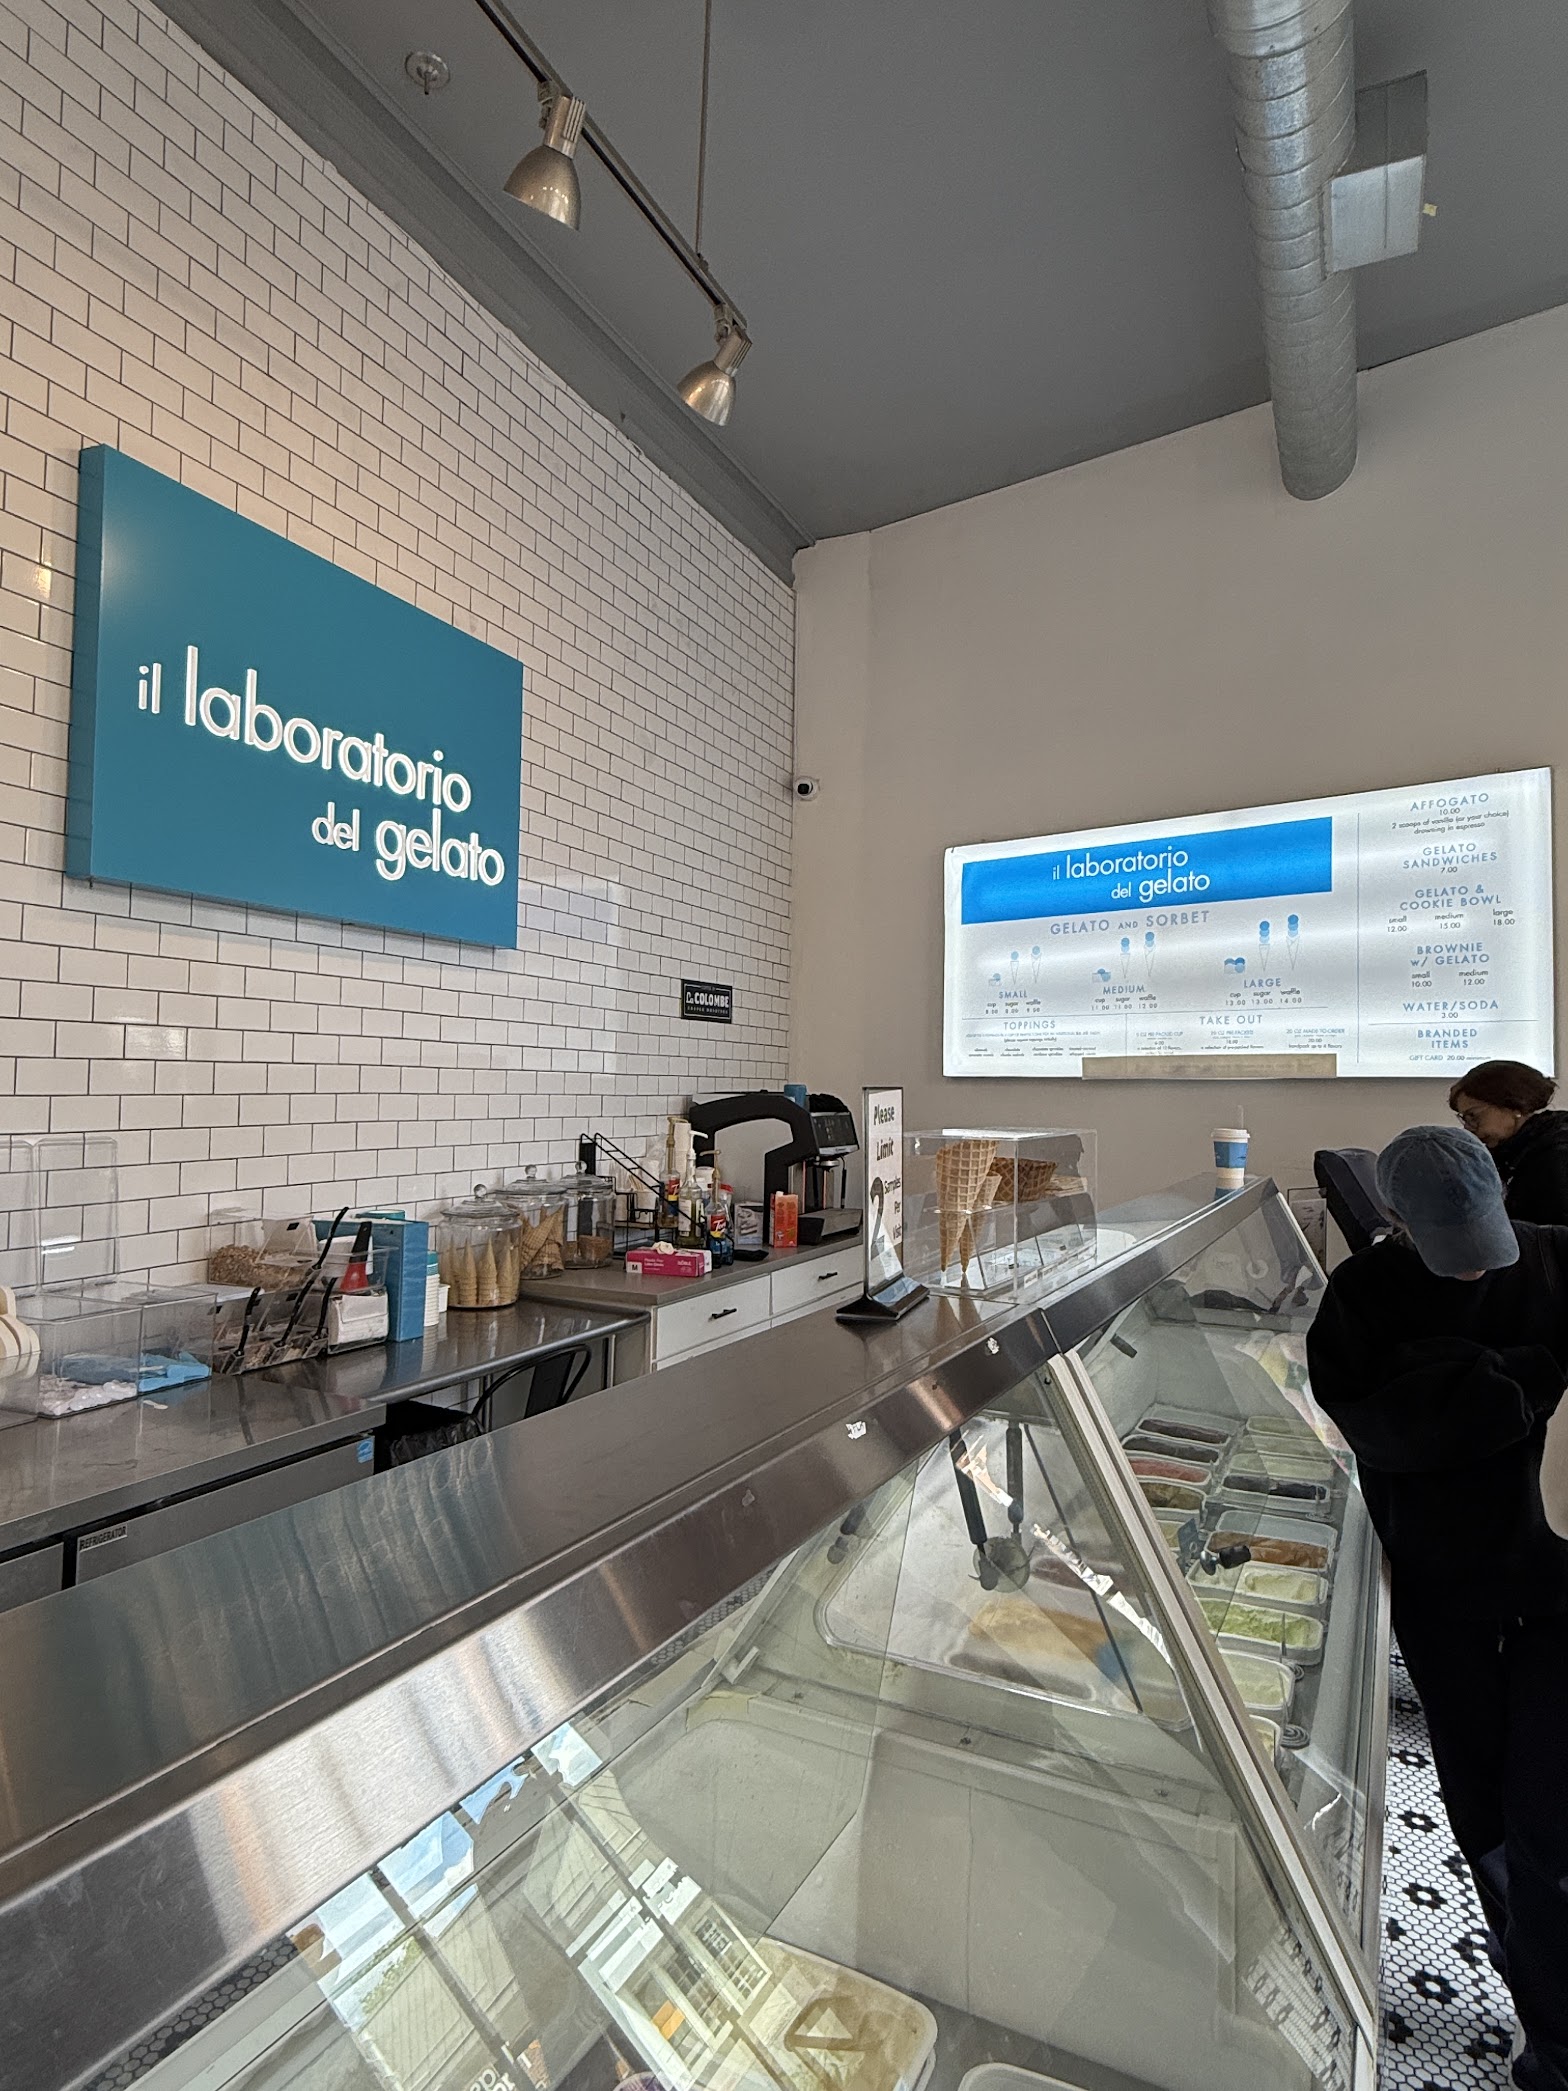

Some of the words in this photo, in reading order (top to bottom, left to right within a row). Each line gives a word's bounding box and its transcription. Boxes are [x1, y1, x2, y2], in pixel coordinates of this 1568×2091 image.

[138, 662, 162, 714] il
[185, 645, 472, 813] laboratorio
[1410, 793, 1489, 811] AFFOGATO
[1423, 818, 1430, 826] of
[1432, 817, 1454, 825] vanilla
[1484, 810, 1509, 819] choice)
[1439, 807, 1461, 816] 10.00
[1414, 826, 1446, 835] drowning
[1456, 822, 1486, 831] espresso
[311, 801, 360, 852] del
[375, 808, 505, 887] gelato
[1423, 843, 1476, 856] GELATO
[1052, 864, 1060, 880] il
[1066, 845, 1189, 879] laboratorio
[1403, 852, 1498, 869] SANDWICHES
[1440, 866, 1458, 874] 7.00
[1111, 881, 1132, 899] del
[1138, 868, 1211, 903] gelato
[1415, 885, 1469, 899] GELATO
[1475, 884, 1485, 894] &
[1400, 899, 1453, 911] COOKIE
[1460, 895, 1501, 907] BOWL
[1435, 912, 1464, 920] medium
[1493, 908, 1514, 917] large
[1050, 919, 1110, 935] GELATO
[1118, 920, 1138, 930] AND
[1146, 910, 1210, 927] SORBET
[1387, 925, 1408, 933] 12.00
[1439, 922, 1461, 930] 15.00
[1493, 918, 1516, 926] 18.00
[1417, 942, 1484, 955] BROWNIE
[1411, 956, 1428, 967] w/
[1435, 953, 1490, 966] GELATO
[1412, 971, 1431, 979] small
[1459, 969, 1489, 977] medium
[1244, 978, 1282, 988] LARGE
[1411, 980, 1432, 988] 10.00
[1463, 978, 1486, 986] 12.00
[999, 989, 1028, 999] SMALL
[1102, 985, 1146, 995] MEDIUM
[1253, 990, 1271, 998] sugar
[1280, 987, 1301, 995] waffle
[695, 992, 729, 1008] COLOMBE
[1115, 996, 1130, 1004] sugar
[1139, 993, 1157, 1001] waffle
[1403, 1000, 1499, 1012] WATER/SODA
[1003, 1020, 1056, 1030] TOPPINGS
[1200, 1015, 1230, 1025] TAKE
[1236, 1014, 1263, 1024] OUT
[1417, 1028, 1478, 1039] BRANDED
[1431, 1039, 1469, 1049] ITEMS
[873, 1104, 895, 1125] Please
[876, 1137, 894, 1161] Limit
[80, 1526, 126, 1551] REFRIGERATOR
